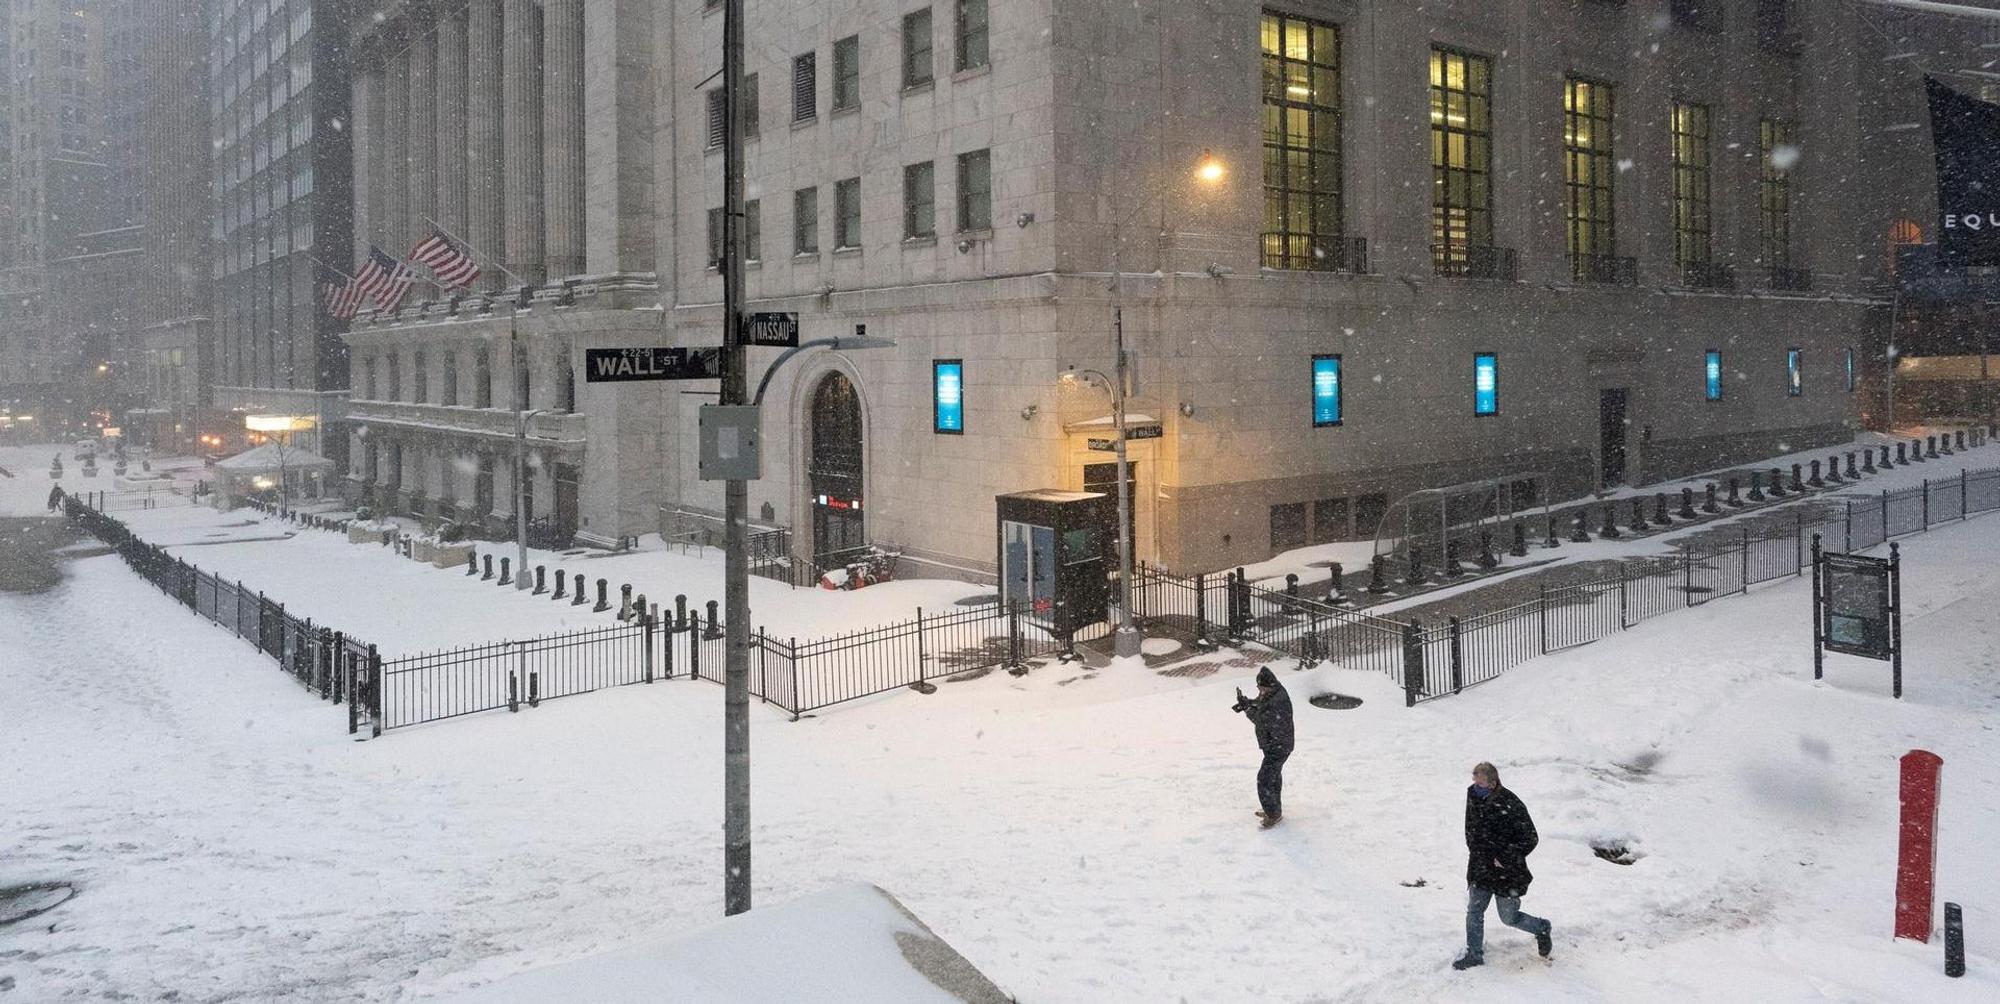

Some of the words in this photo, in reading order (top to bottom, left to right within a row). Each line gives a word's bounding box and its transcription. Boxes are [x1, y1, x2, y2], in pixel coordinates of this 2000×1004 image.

[1944, 213, 2000, 230] EQU
[756, 321, 789, 340] NASSAU
[790, 321, 797, 332] ST
[596, 356, 665, 376] WALL
[663, 355, 678, 366] ST
